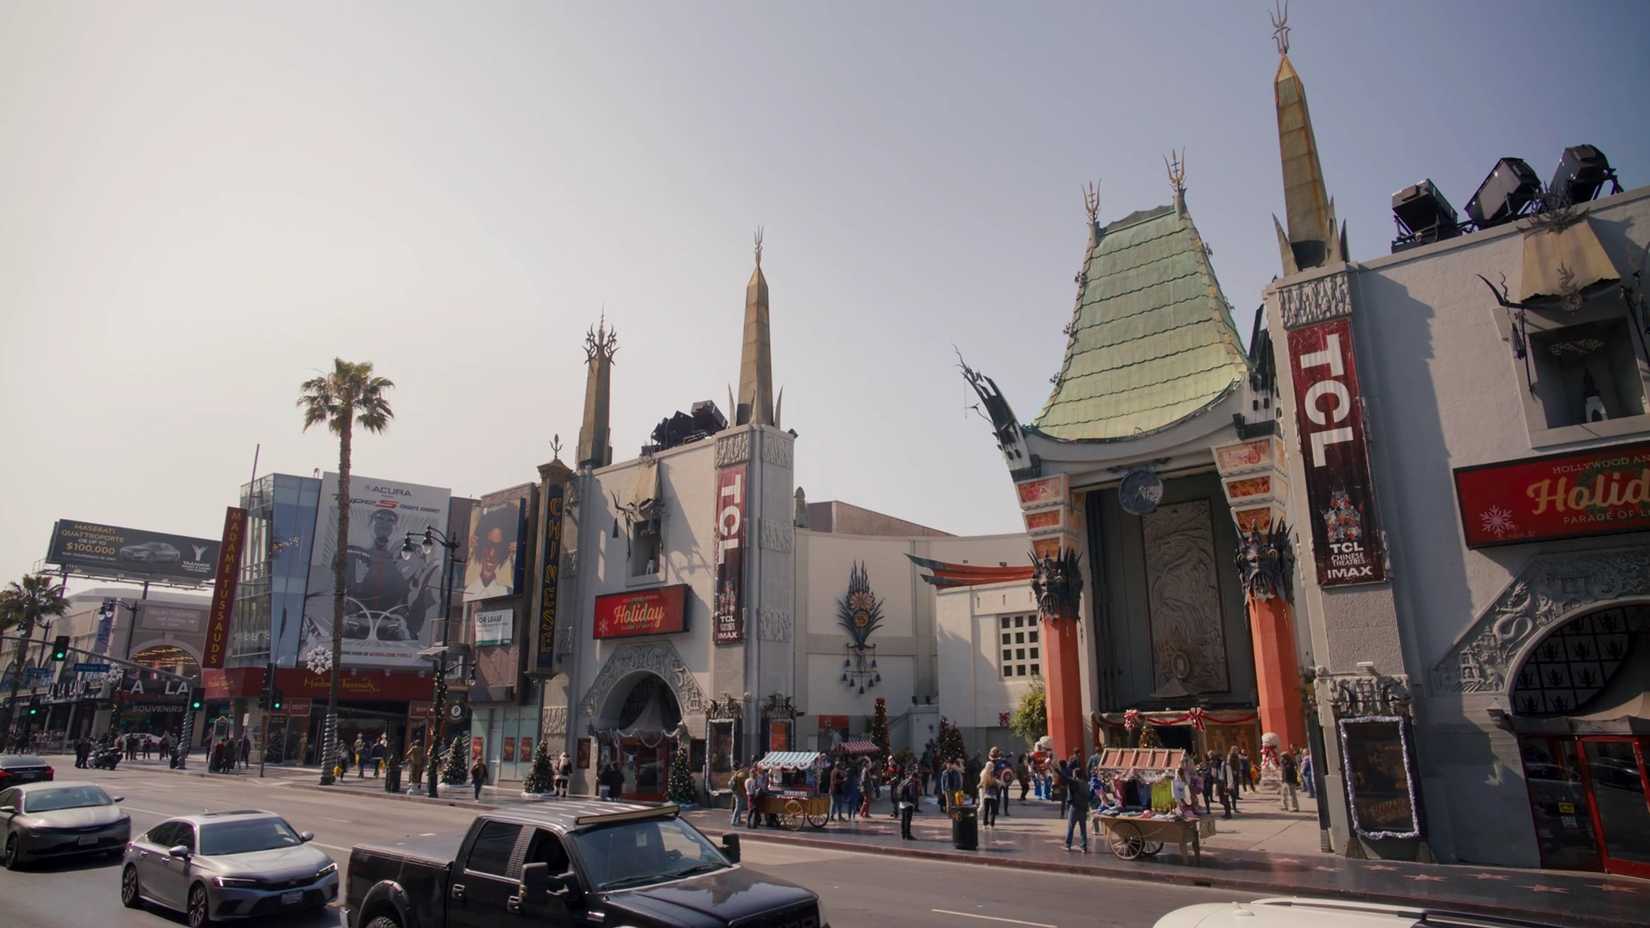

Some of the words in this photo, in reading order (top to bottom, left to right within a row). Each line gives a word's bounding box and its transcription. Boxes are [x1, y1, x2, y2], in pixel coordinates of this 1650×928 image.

[1300, 334, 1354, 467] TCL
[373, 486, 413, 497] ACURA
[718, 474, 743, 565] TCL
[224, 511, 241, 575] MADAME
[1329, 542, 1363, 553] TCL
[1327, 566, 1373, 578] IMAX
[208, 579, 230, 665] TUSSAUDS
[614, 604, 664, 628] Holiday
[720, 615, 735, 623] TCL
[132, 704, 184, 713] SOUVENIRS
